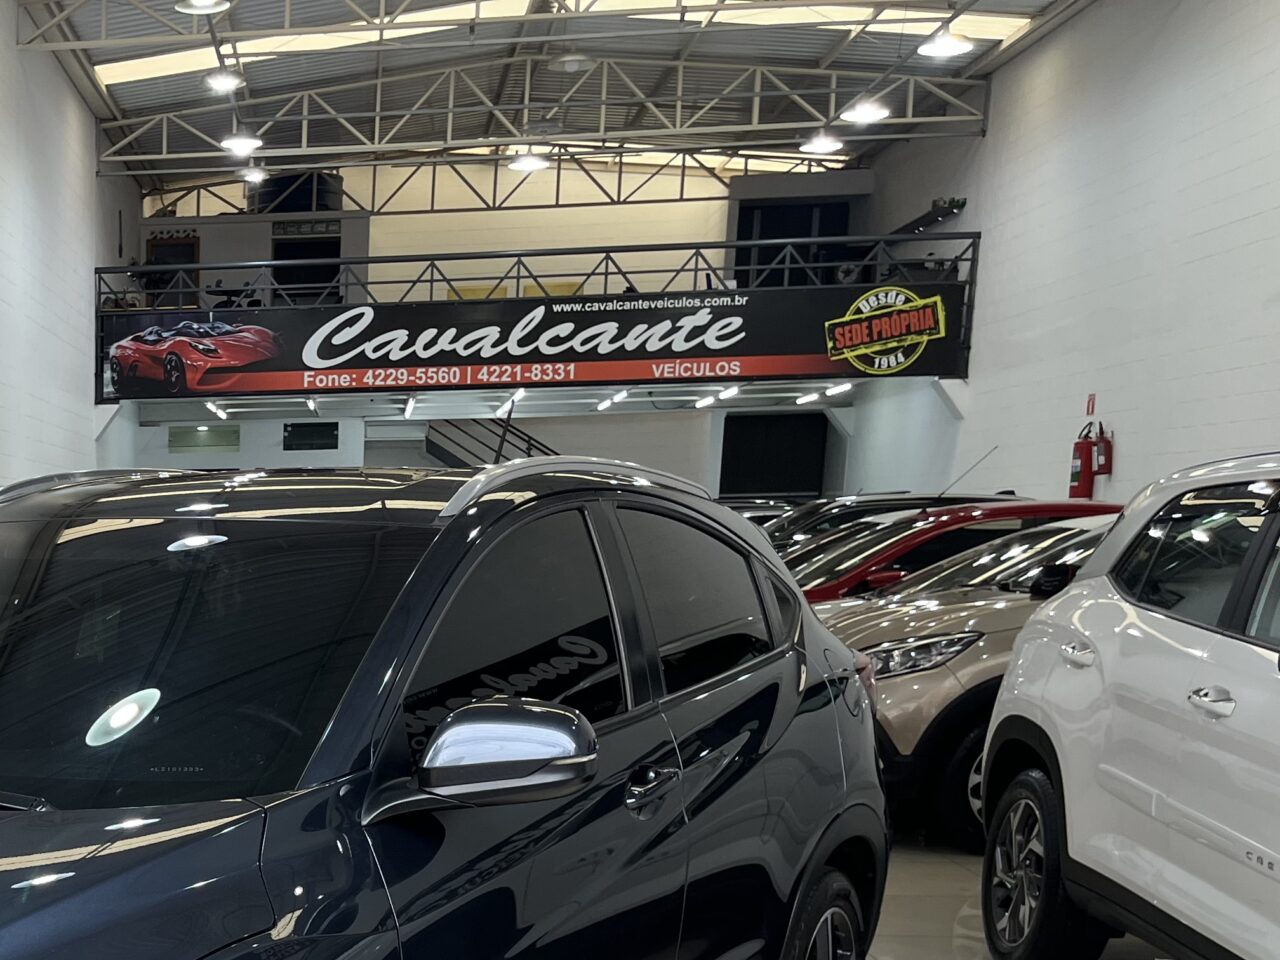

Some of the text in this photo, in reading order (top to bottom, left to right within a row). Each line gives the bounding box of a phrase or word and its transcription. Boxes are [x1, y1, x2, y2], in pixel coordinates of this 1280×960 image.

[552, 296, 749, 313] www.cavalcanteveiculos.com.br
[302, 305, 746, 369] Cavalcante
[834, 307, 935, 349] SEDE PRÓPRIA
[652, 360, 741, 378] VEÍCULOS
[874, 352, 905, 369] 1984
[304, 371, 357, 388] Fone:
[363, 368, 461, 386] 4229-5560
[477, 363, 576, 382] 4221-8331
